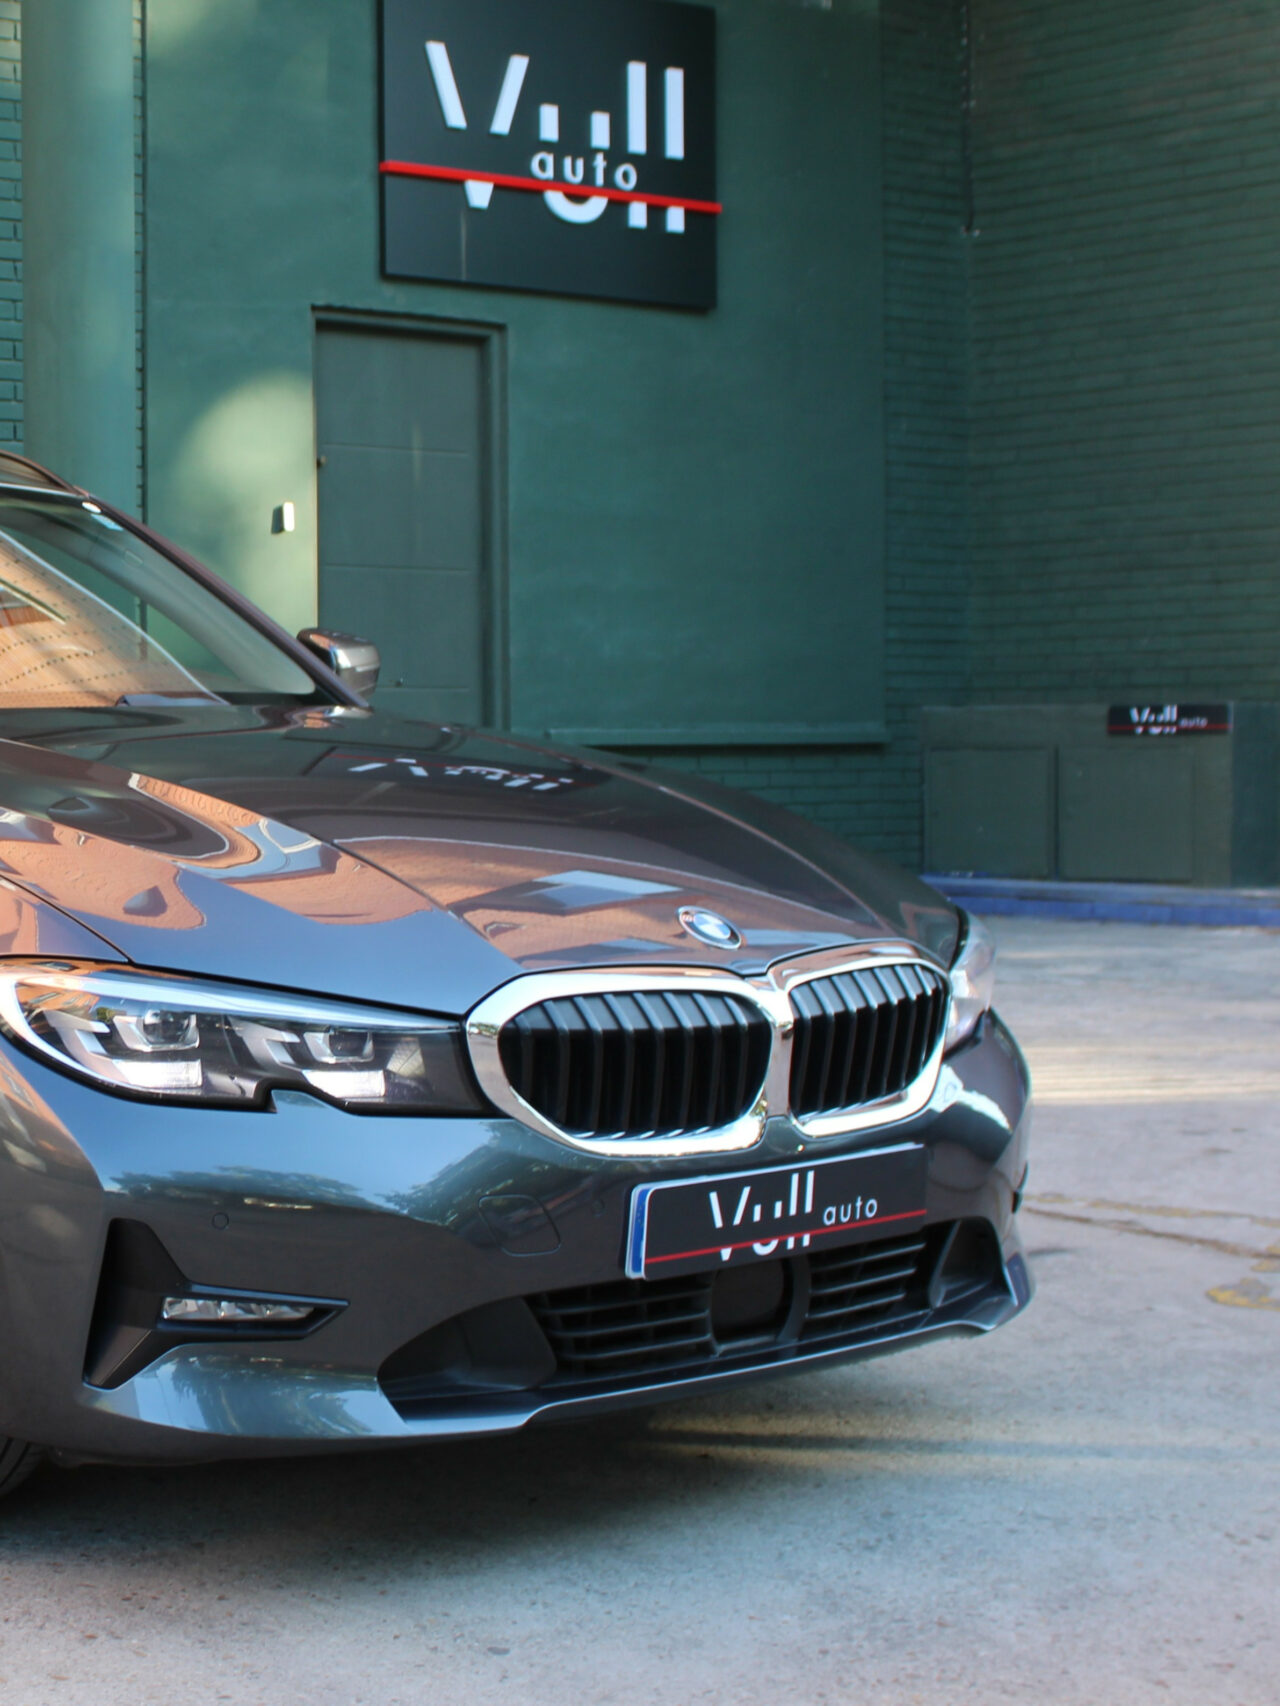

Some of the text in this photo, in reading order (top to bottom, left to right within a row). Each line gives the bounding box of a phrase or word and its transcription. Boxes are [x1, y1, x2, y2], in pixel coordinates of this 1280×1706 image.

[530, 151, 638, 191] auto
[1179, 716, 1209, 728] auto
[823, 1196, 878, 1226] auto
